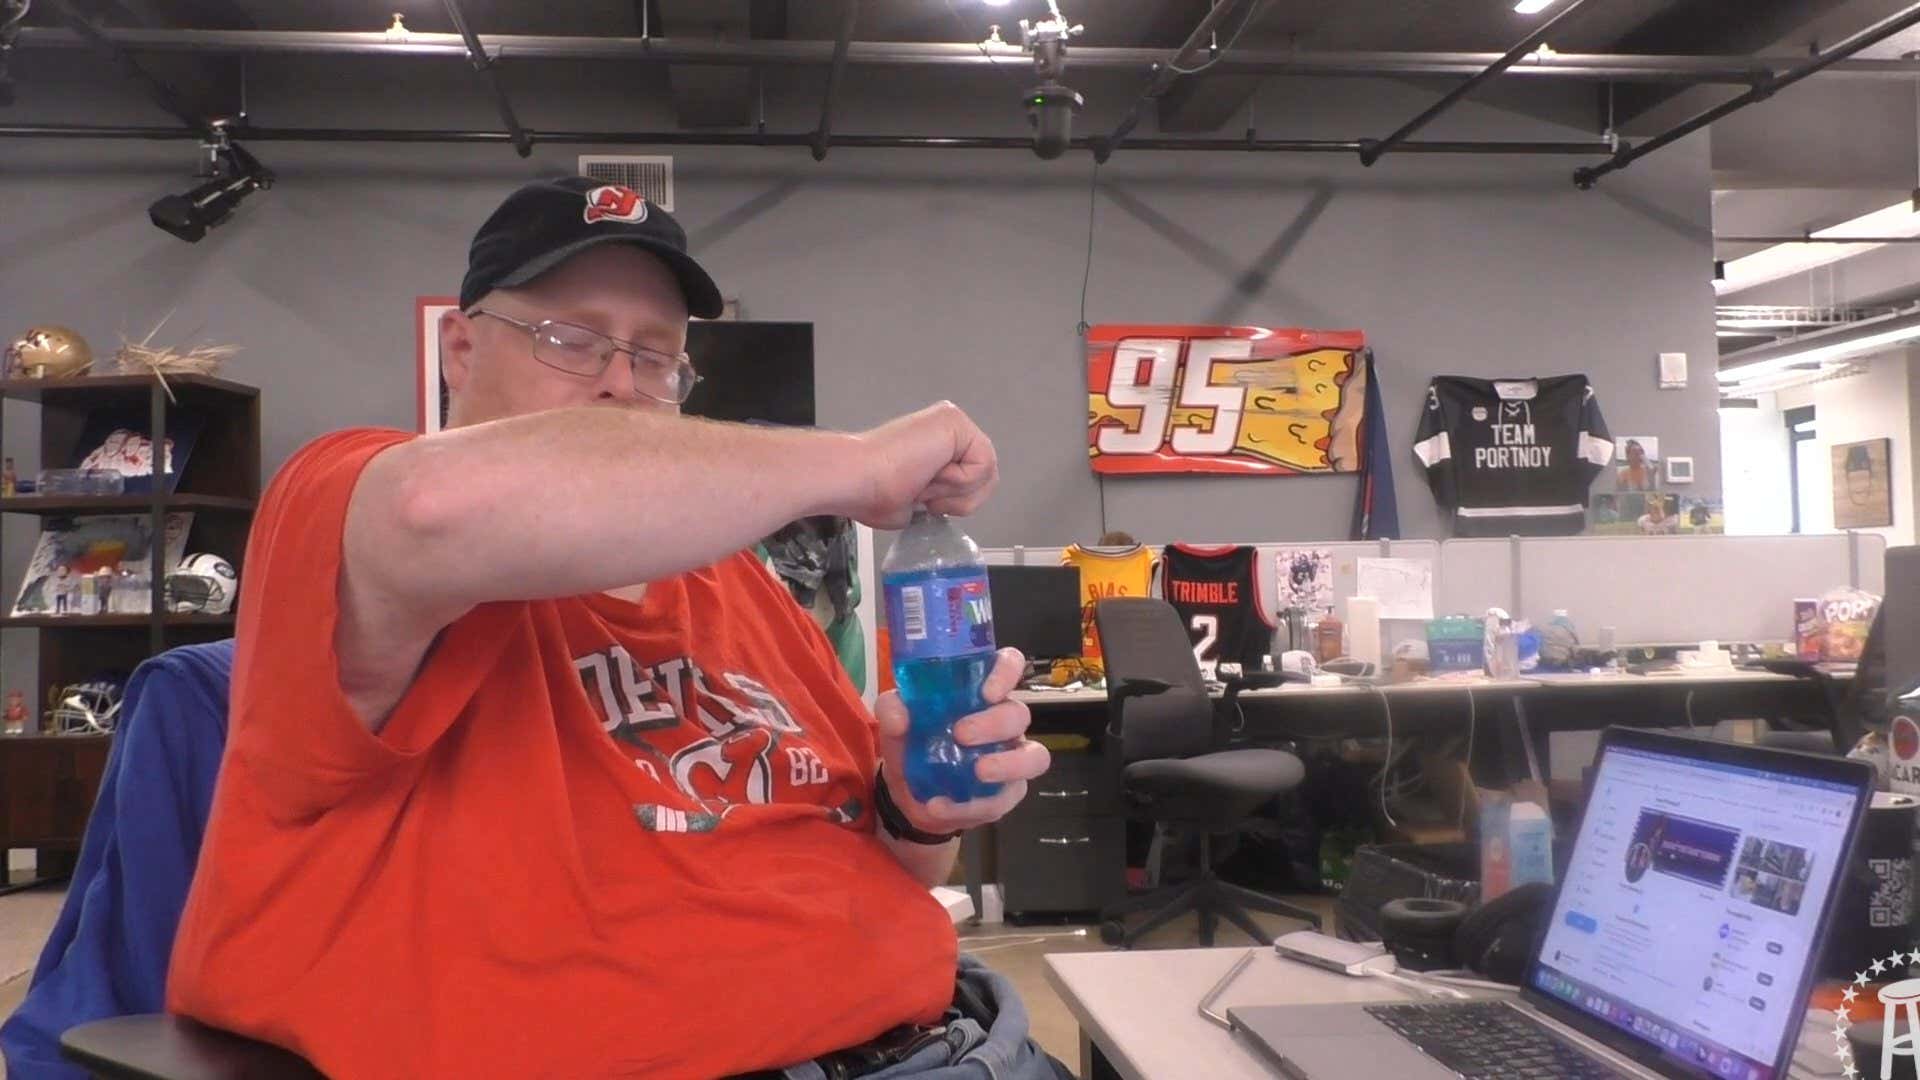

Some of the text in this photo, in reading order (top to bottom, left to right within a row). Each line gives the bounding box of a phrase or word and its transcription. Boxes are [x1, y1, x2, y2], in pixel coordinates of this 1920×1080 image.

[1098, 338, 1254, 455] 95
[1491, 423, 1536, 446] TEAM
[1475, 447, 1552, 469] PORTNOY
[1172, 580, 1239, 604] TRIMBLE
[1192, 614, 1218, 681] 2
